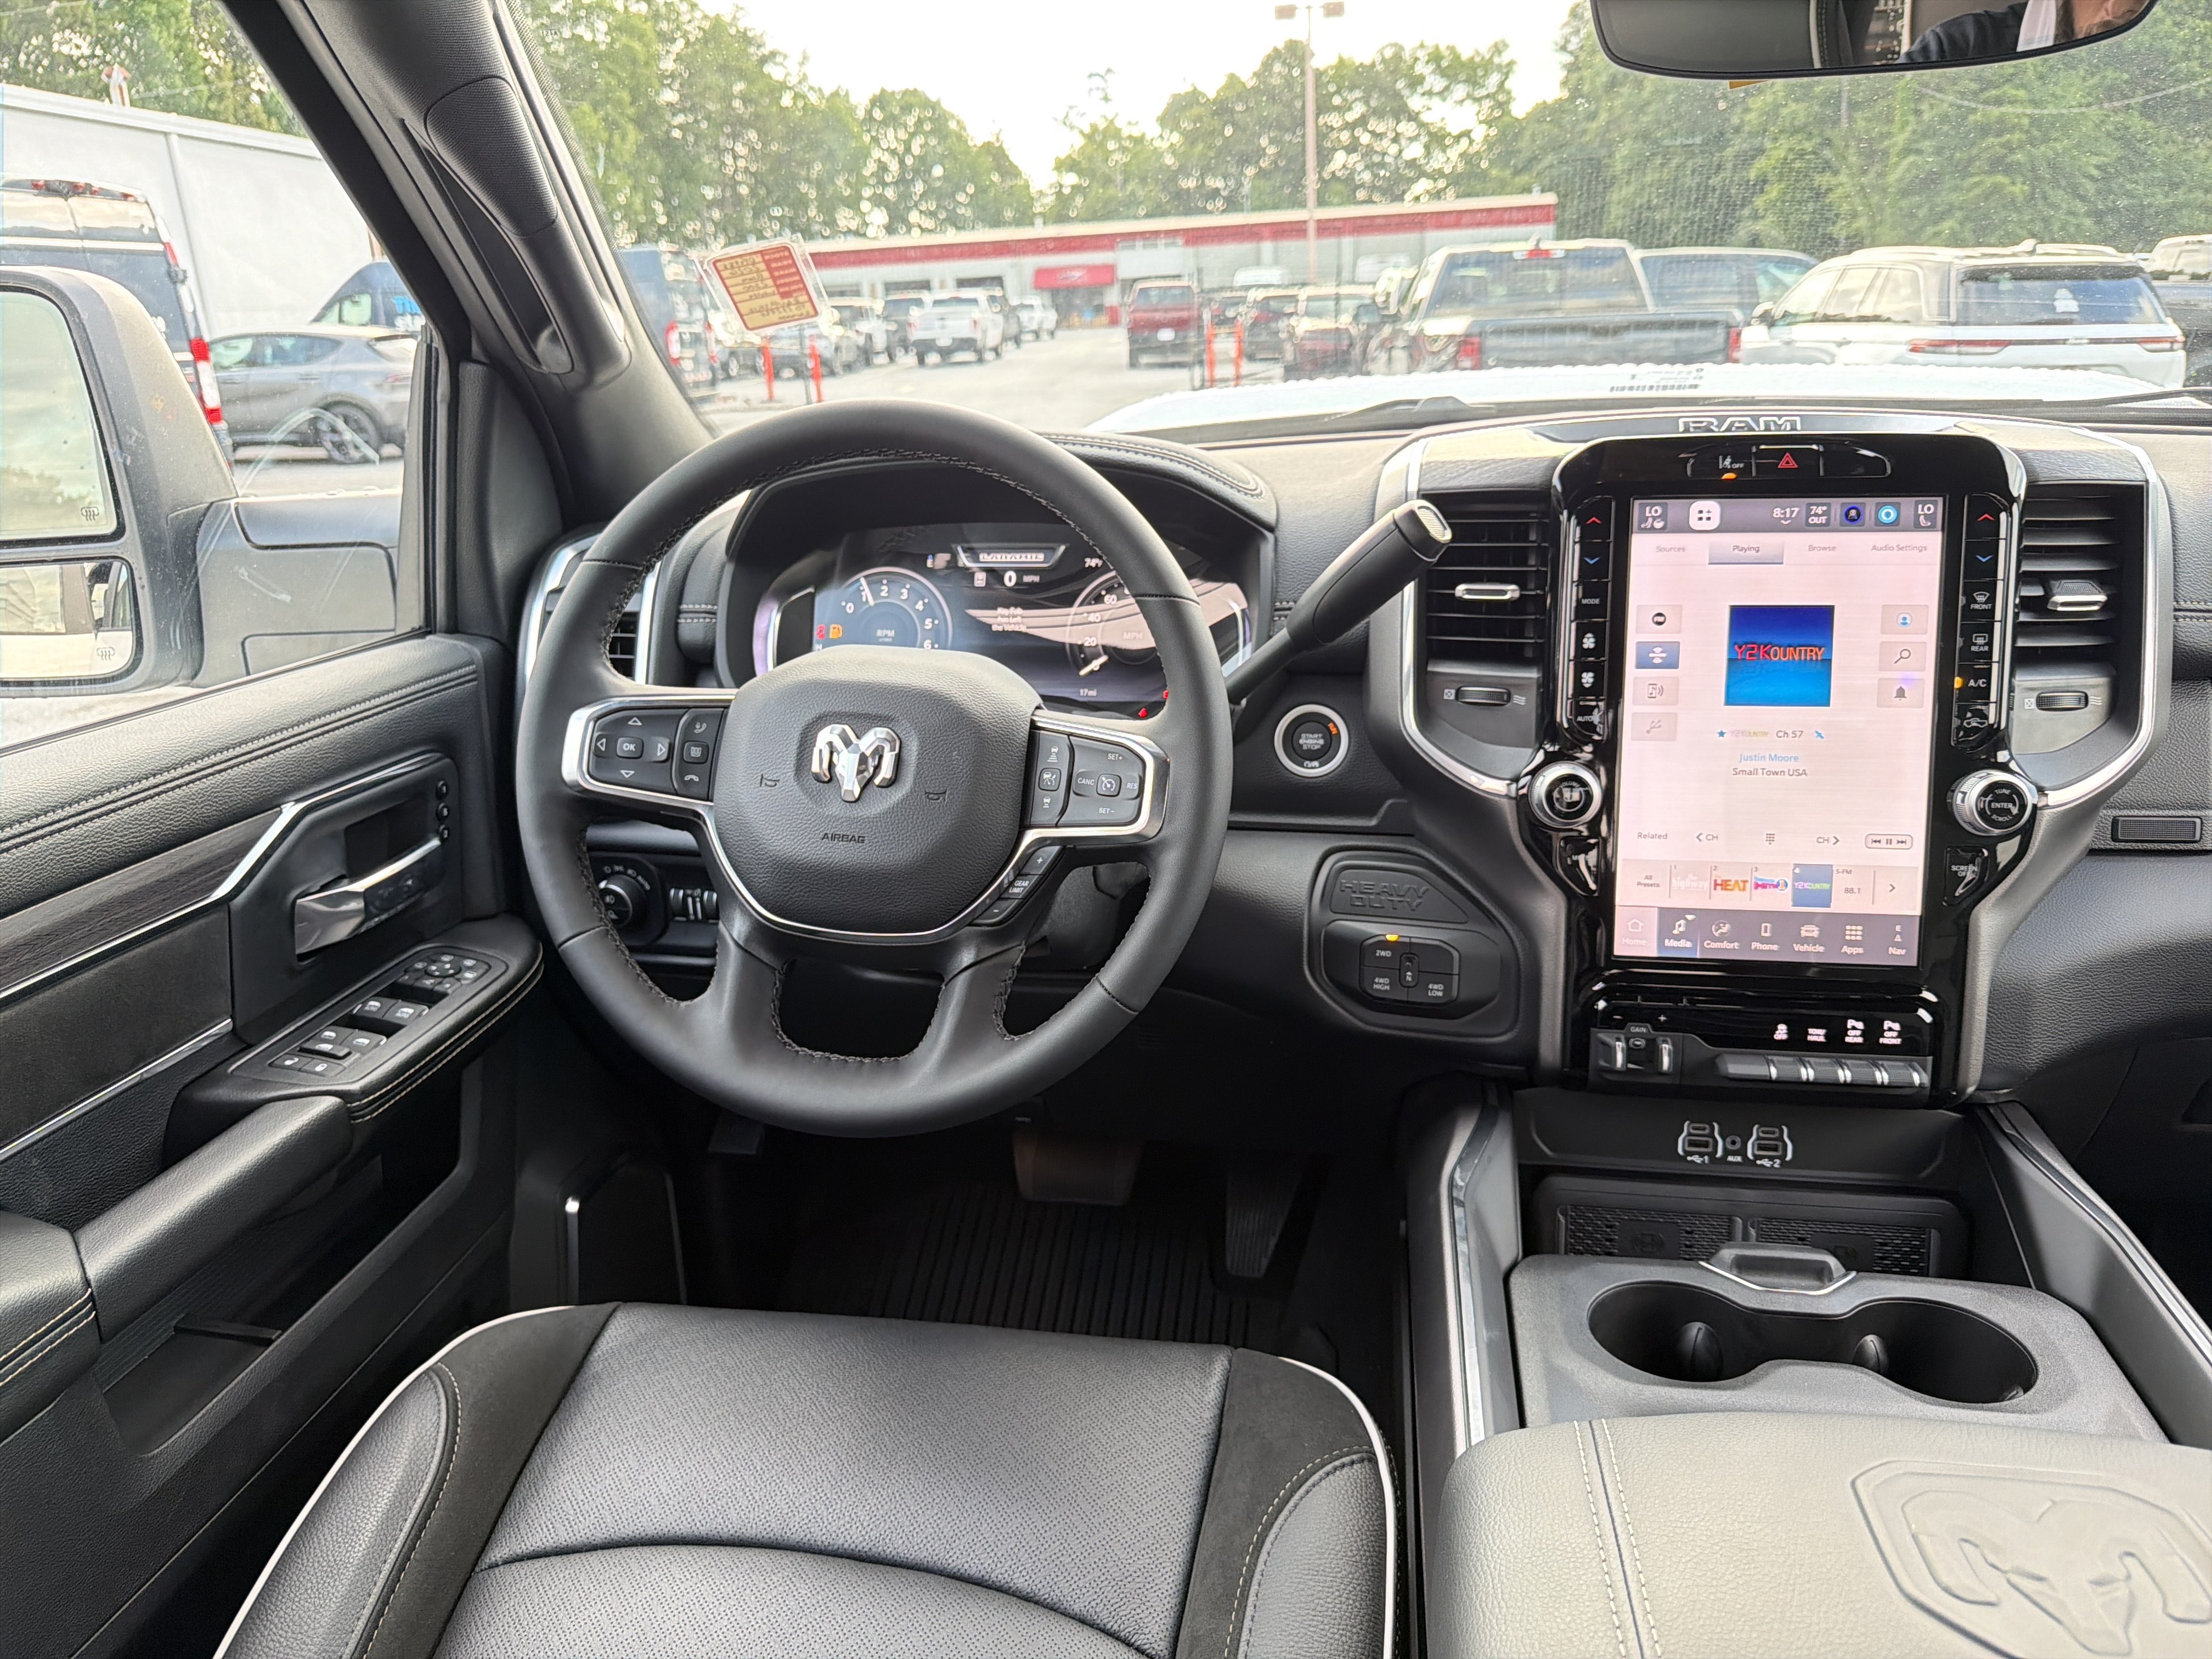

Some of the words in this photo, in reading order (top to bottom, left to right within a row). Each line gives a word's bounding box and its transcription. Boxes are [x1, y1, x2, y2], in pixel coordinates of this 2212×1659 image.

[1679, 416, 1801, 432] RAM
[1646, 505, 1662, 516] LO
[1773, 507, 1799, 518] 8:17
[1918, 504, 1934, 514] LO
[1733, 545, 1760, 554] Playing
[1896, 544, 1927, 553] Settings
[1003, 570, 1017, 587] 0
[881, 586, 889, 597] 2
[900, 588, 908, 599] 3
[1104, 594, 1117, 605] 60
[845, 603, 854, 613] 0
[915, 601, 924, 611] 4
[1088, 613, 1101, 622] 40
[924, 618, 932, 629] 5
[1123, 631, 1143, 640] MPH
[924, 640, 932, 650] 6
[1084, 637, 1097, 646] 20
[1968, 678, 1987, 687] A/C
[1775, 730, 1788, 738] Ch
[1791, 730, 1803, 738] 57
[623, 743, 636, 752] OK
[1739, 753, 1766, 763] Justin
[1768, 754, 1799, 762] Moore
[1733, 768, 1758, 776] Small
[1760, 768, 1785, 776] Town
[1077, 777, 1094, 786] CANC
[1991, 814, 2013, 822] SCROLL
[822, 832, 866, 844] AIRBAG
[1637, 832, 1668, 840] Related
[1706, 833, 1719, 842] CH
[1816, 836, 1830, 845] CH
[1340, 879, 1429, 898] HEAVY
[1713, 878, 1749, 891] HEAT
[1350, 894, 1424, 911] DUTY
[1622, 938, 1647, 946] Home
[1664, 939, 1692, 948] Media
[1703, 940, 1740, 950] Comfort
[1751, 942, 1779, 951] Phone
[1793, 943, 1826, 952] Vehicle
[1841, 945, 1864, 955] Apps
[1888, 947, 1906, 955] Nav
[1703, 1155, 1709, 1164] 1
[1773, 1159, 1781, 1168] 2
